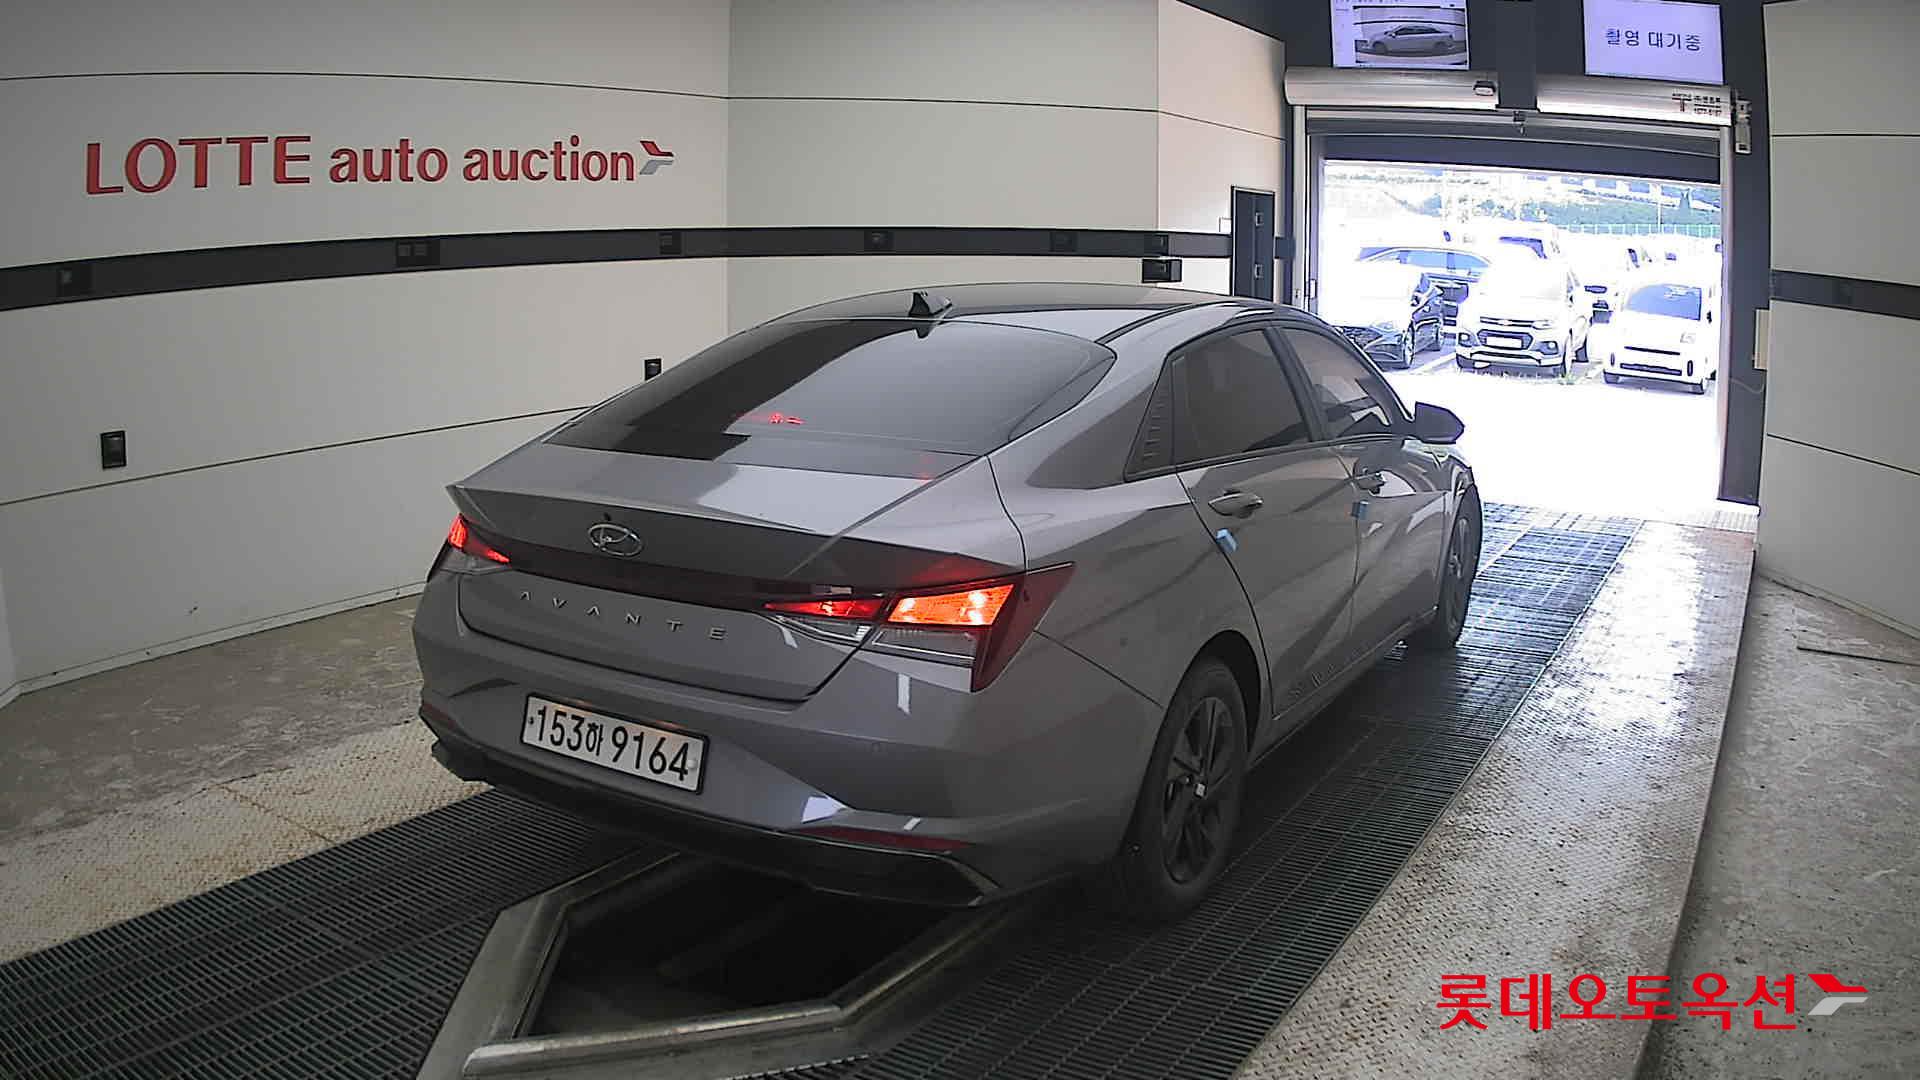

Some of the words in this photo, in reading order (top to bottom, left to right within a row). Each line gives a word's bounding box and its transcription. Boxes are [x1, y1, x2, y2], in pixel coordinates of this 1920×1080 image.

[86, 135, 311, 195] LOTTE
[329, 138, 448, 183] auto
[463, 135, 635, 182] auction
[519, 590, 727, 641] AVANTE
